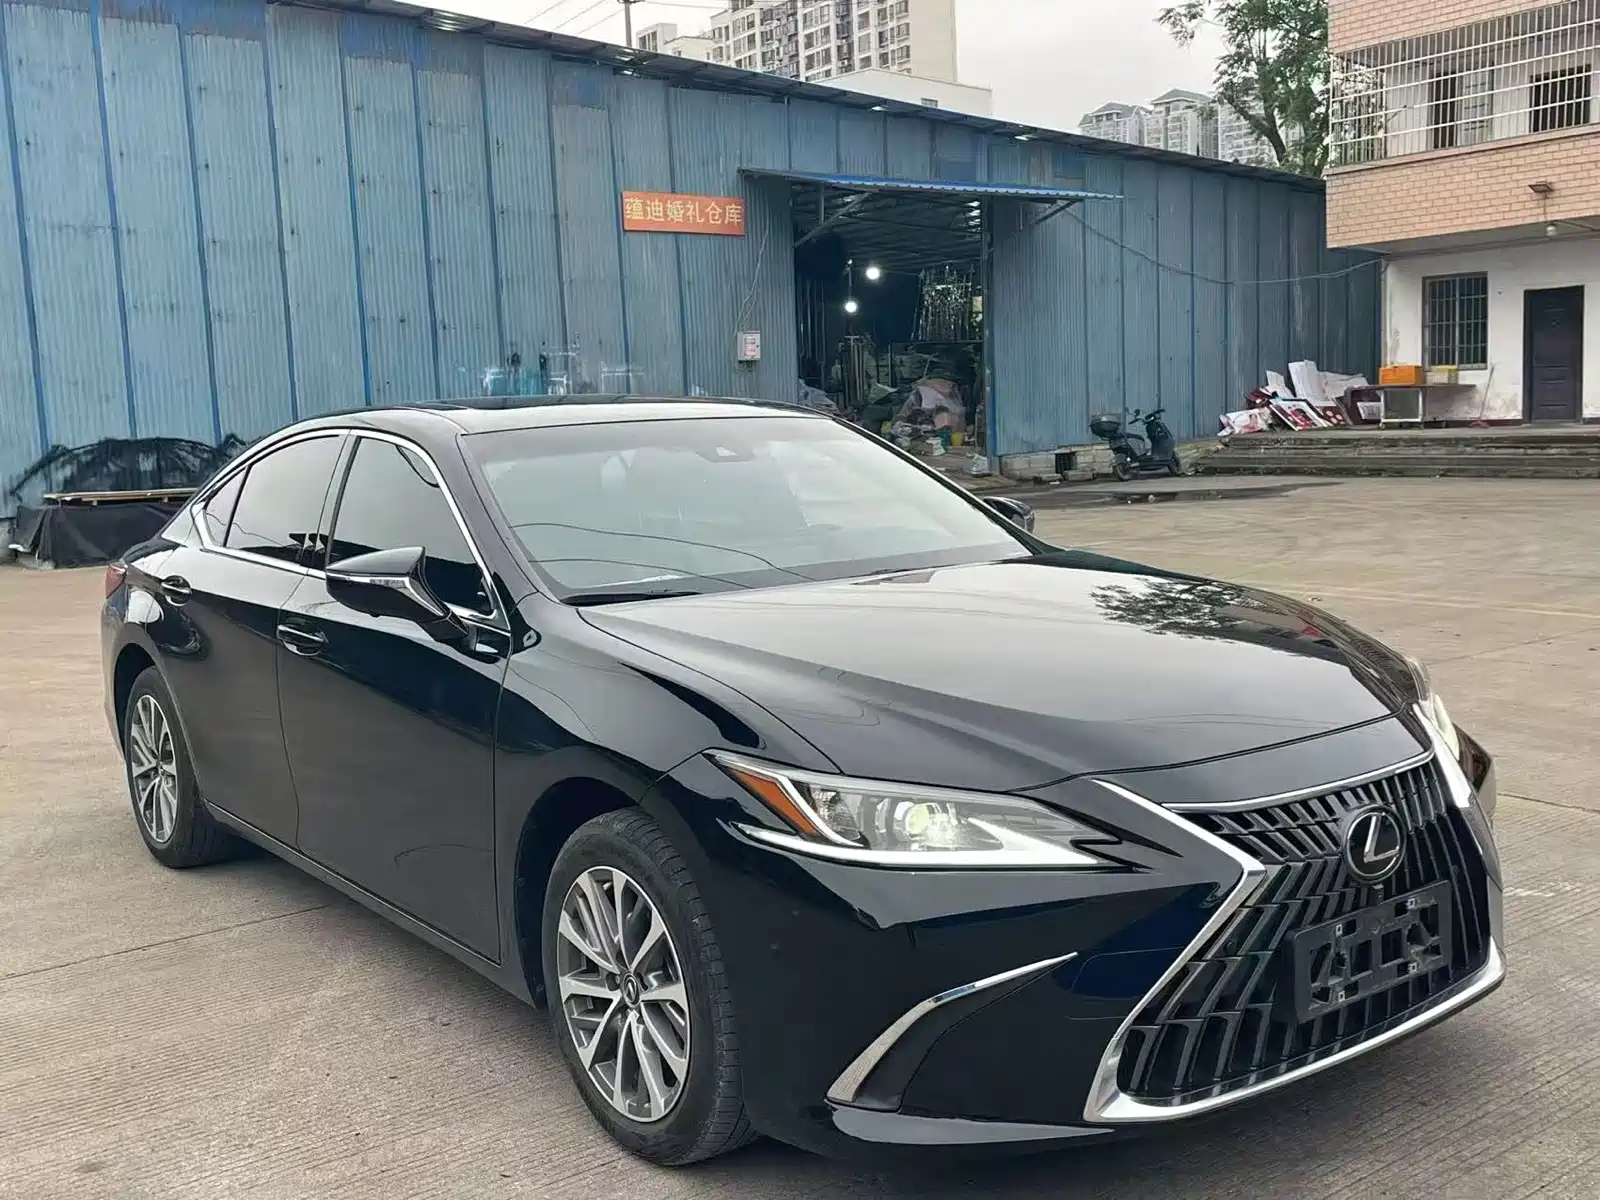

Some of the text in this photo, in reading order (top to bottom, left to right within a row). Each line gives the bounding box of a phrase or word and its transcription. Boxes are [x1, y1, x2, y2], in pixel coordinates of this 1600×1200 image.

[624, 197, 742, 226] 蕴迪婚礼仓库
